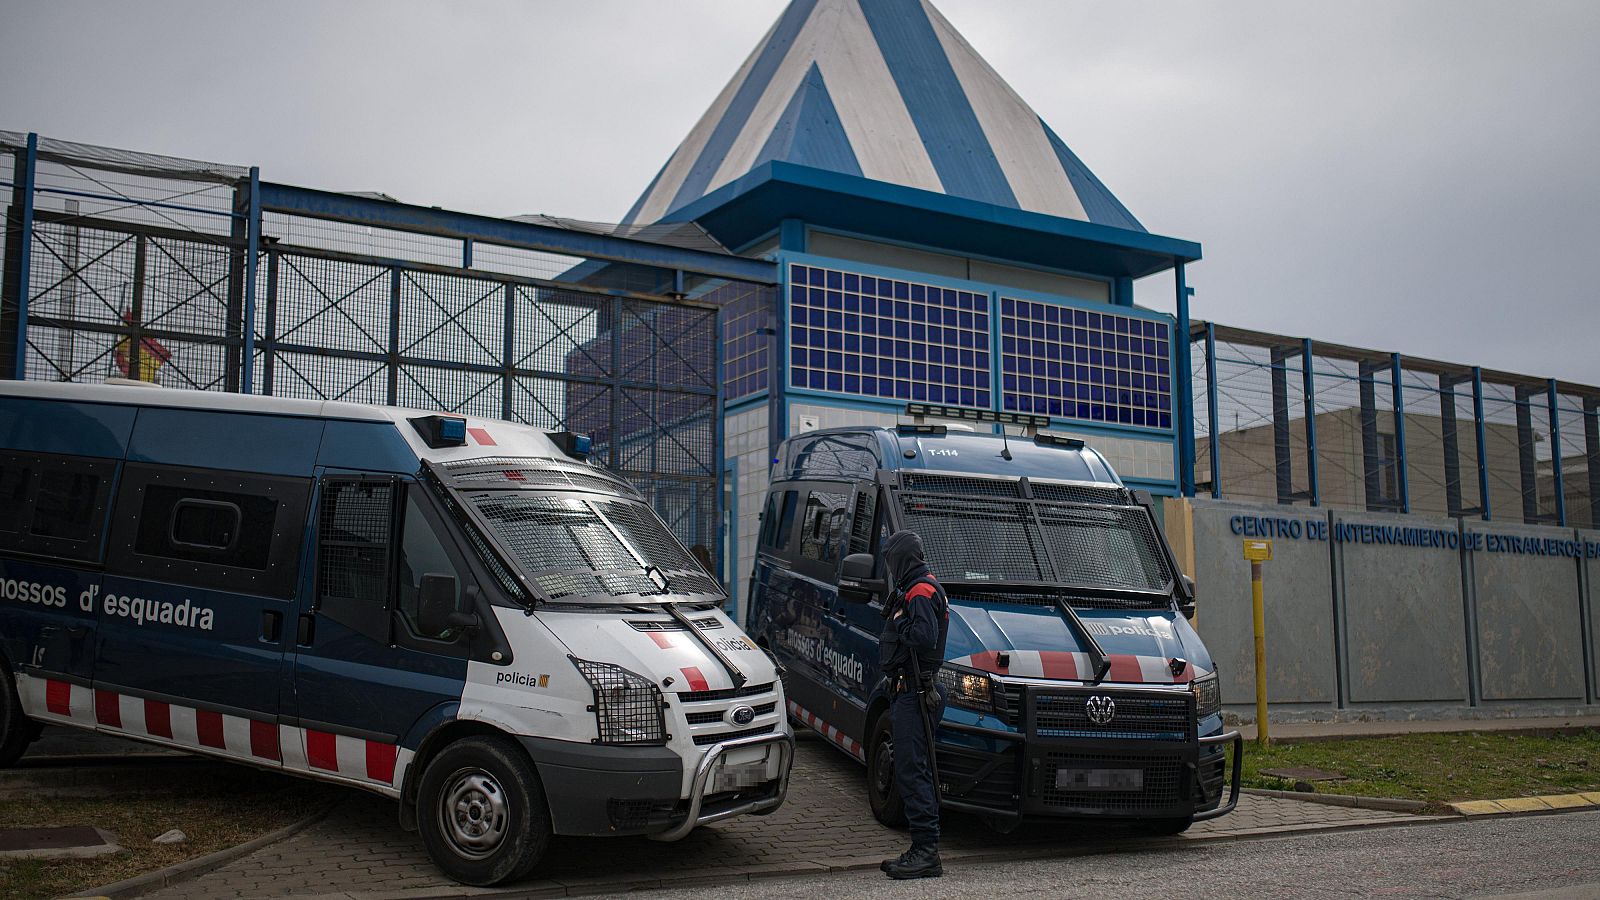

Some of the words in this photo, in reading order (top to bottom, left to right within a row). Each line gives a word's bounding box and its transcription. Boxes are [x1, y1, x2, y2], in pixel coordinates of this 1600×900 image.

[928, 449, 959, 457] T-114
[1230, 515, 1303, 540] CENTRO
[1306, 520, 1329, 541] DE
[1335, 523, 1459, 549] INTERNAMIENTO
[1461, 531, 1483, 551] DE
[1486, 534, 1585, 558] EXTRANJEROS
[0, 578, 66, 607] ossos
[103, 594, 214, 630] esquadra
[1108, 625, 1174, 640] policia
[716, 637, 752, 651] olicia
[787, 628, 815, 659] mossos
[496, 671, 537, 687] policia
